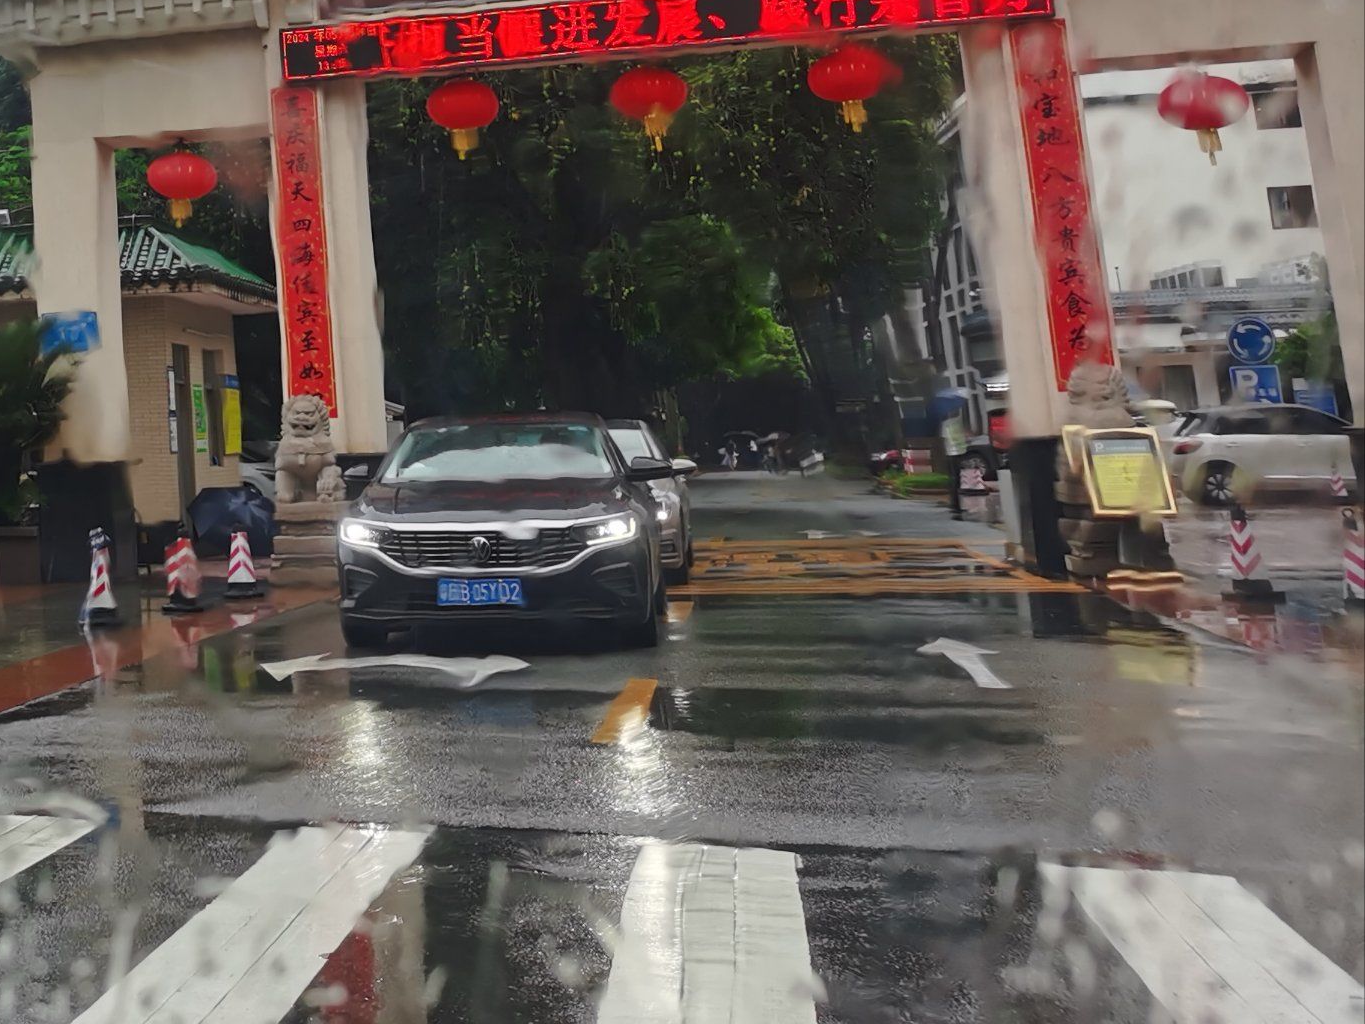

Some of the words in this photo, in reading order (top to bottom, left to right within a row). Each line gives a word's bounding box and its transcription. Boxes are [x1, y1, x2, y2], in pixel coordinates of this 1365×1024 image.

[280, 95, 324, 400] 喜庆福天四海佳宾至如
